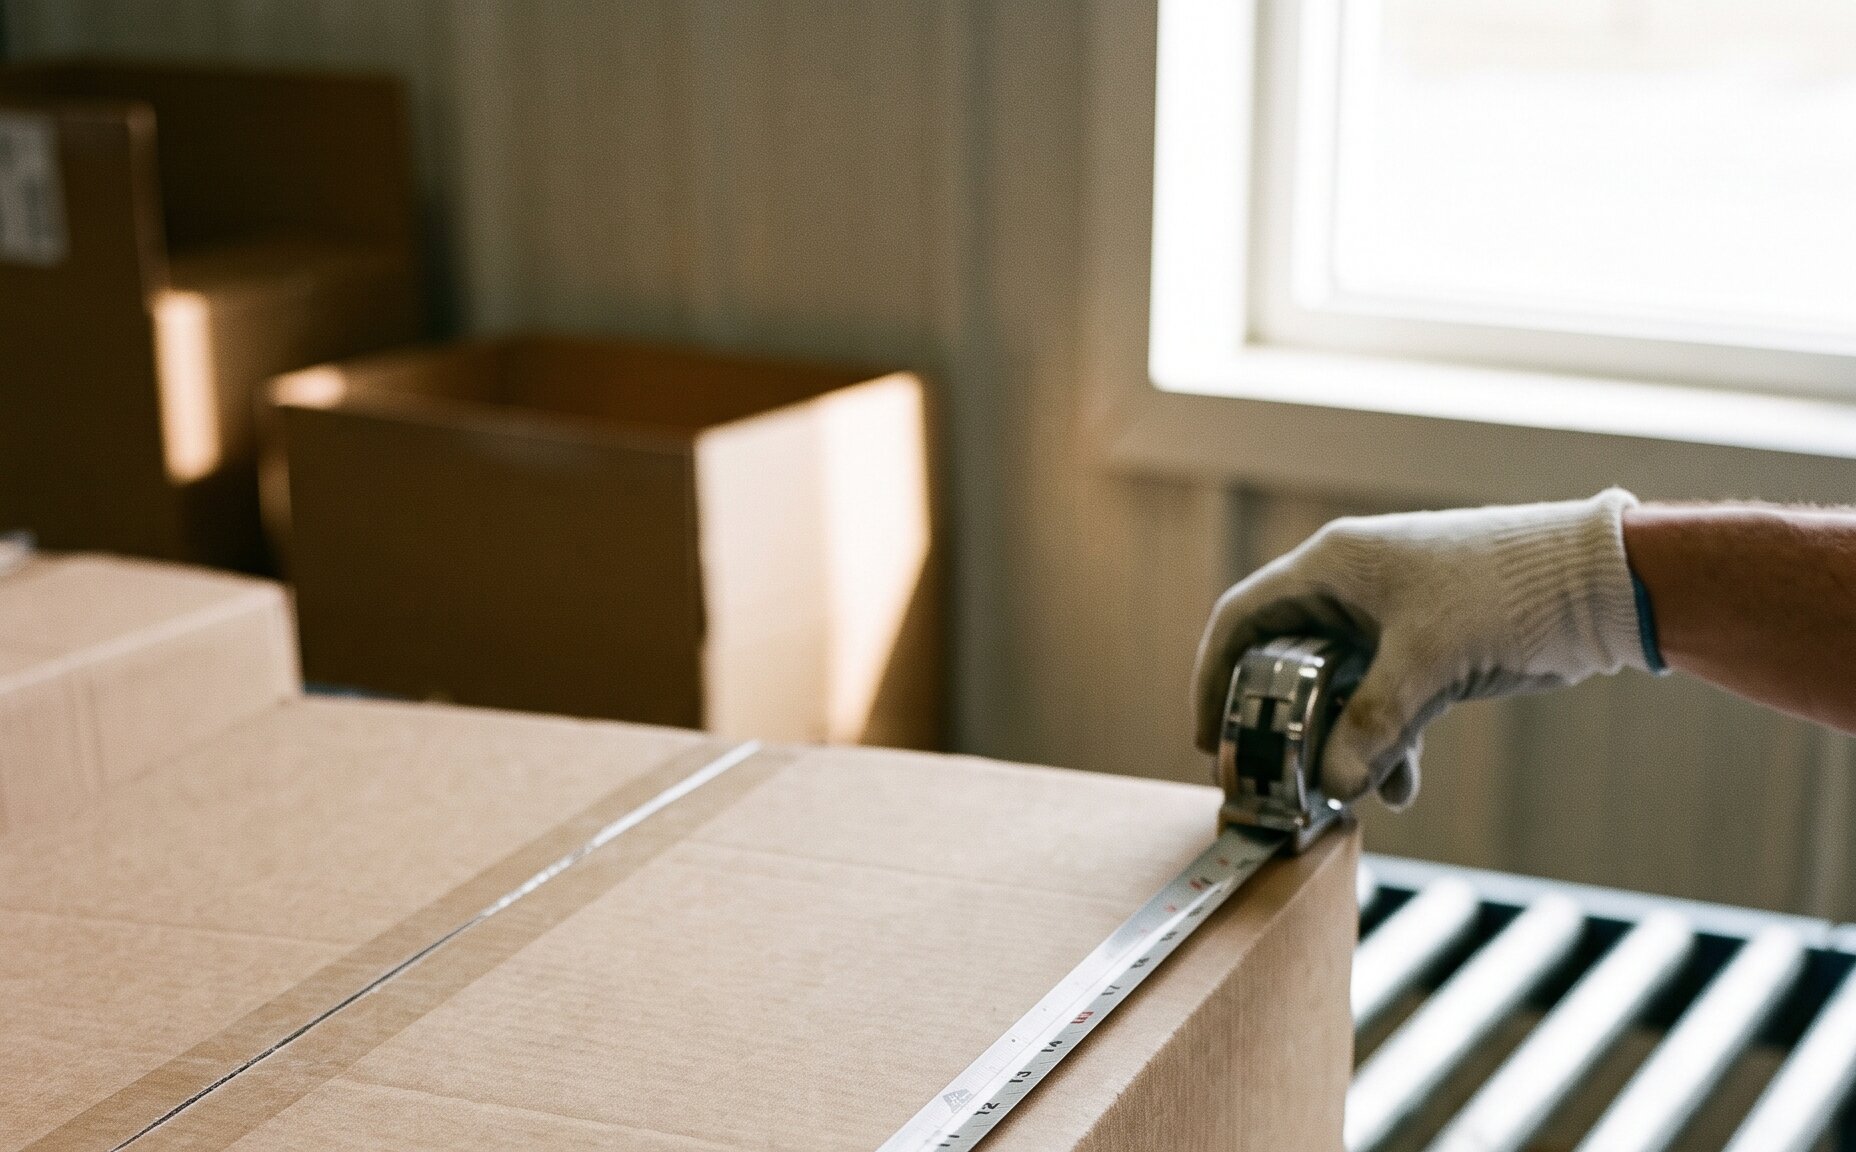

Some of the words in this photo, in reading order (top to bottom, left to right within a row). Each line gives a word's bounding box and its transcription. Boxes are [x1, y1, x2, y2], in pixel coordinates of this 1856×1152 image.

[973, 1102, 1001, 1116] 12
[1008, 1070, 1032, 1084] 13
[1040, 1040, 1063, 1053] 14
